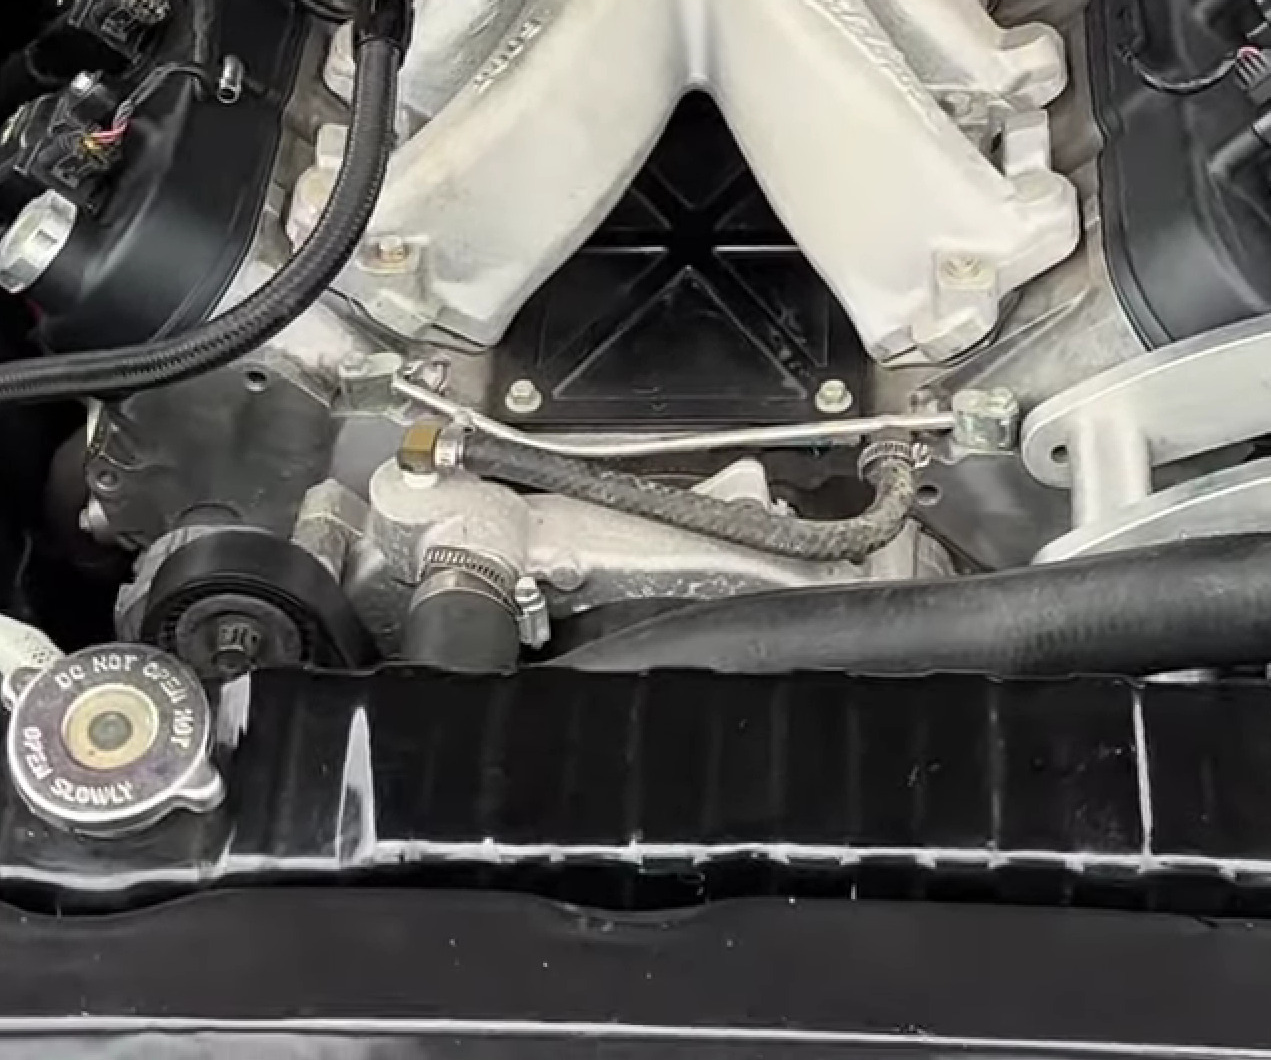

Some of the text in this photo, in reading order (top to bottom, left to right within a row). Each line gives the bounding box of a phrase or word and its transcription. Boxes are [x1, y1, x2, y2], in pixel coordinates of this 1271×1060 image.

[54, 652, 195, 749] DO NOT OPEN HOT
[22, 726, 135, 806] OPEN SLOWLY
